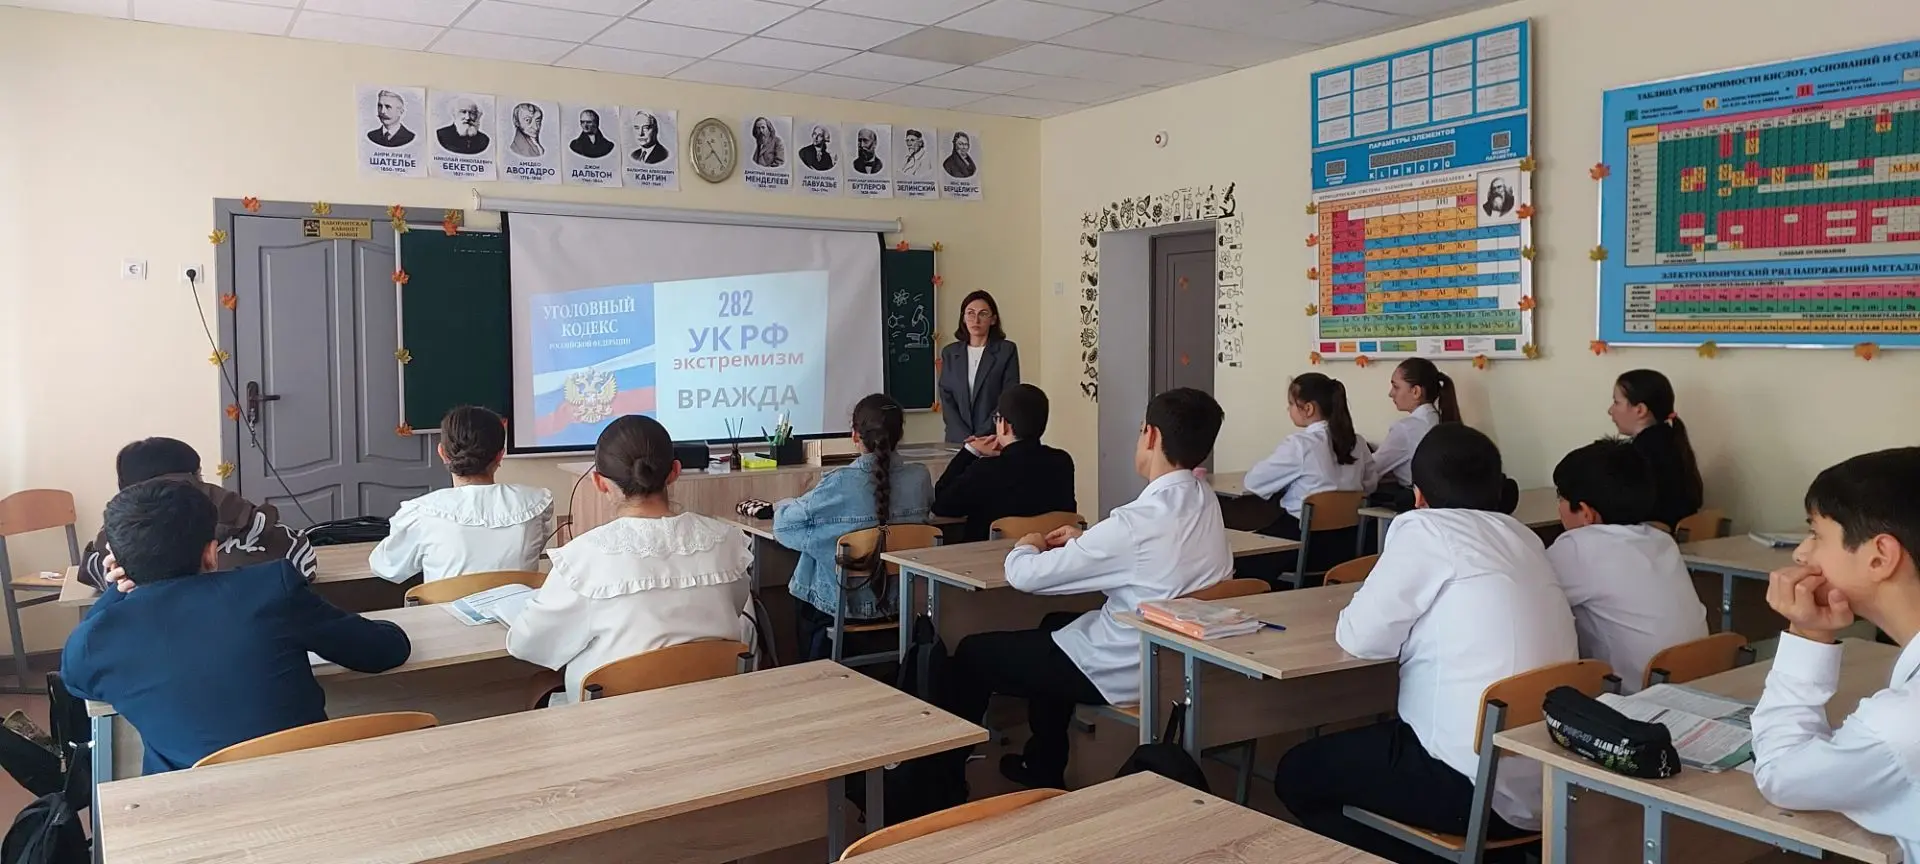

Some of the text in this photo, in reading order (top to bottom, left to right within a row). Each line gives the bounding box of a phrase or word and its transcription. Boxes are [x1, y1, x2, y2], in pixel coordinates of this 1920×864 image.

[1638, 88, 1678, 100] ТАБЛИЦА
[1679, 76, 1762, 94] РАСТВОРИМОСТИ
[1763, 68, 1807, 81] КИСЛОТ,
[1809, 54, 1880, 74] ОСНОВАНИЙ
[1894, 50, 1920, 60] СОЛ
[1706, 99, 1715, 108] М
[1369, 128, 1456, 149] ПАРАМЕТРЫ ЭЛЕМЕНТОВ
[369, 158, 416, 168] ШАТЕЛЬЕ
[442, 162, 484, 172] БЕКЕТОВ
[506, 166, 556, 176] АВОГАДРО
[571, 170, 612, 179] ДАЛЬТОН
[634, 174, 666, 182] КАРГИН
[745, 175, 788, 185] МЕНДЕЛЕЕВ
[802, 180, 837, 188] ЛАВУАЗЬЕ
[1662, 268, 1769, 279] ЭЛЕКТРОХИМИЧЕСКИЙ
[1771, 267, 1791, 276] РЯД
[1794, 264, 1869, 275] НАПРЯЖЕНИЙ
[543, 295, 636, 320] УГОЛОВНЫЙ
[719, 290, 753, 318] 282
[561, 319, 618, 338] КОДЕКС
[688, 322, 788, 352] УК РФ
[674, 352, 804, 373] экстремизм
[678, 385, 799, 412] ВРАЖДА
[1594, 738, 1613, 752] SLAM
